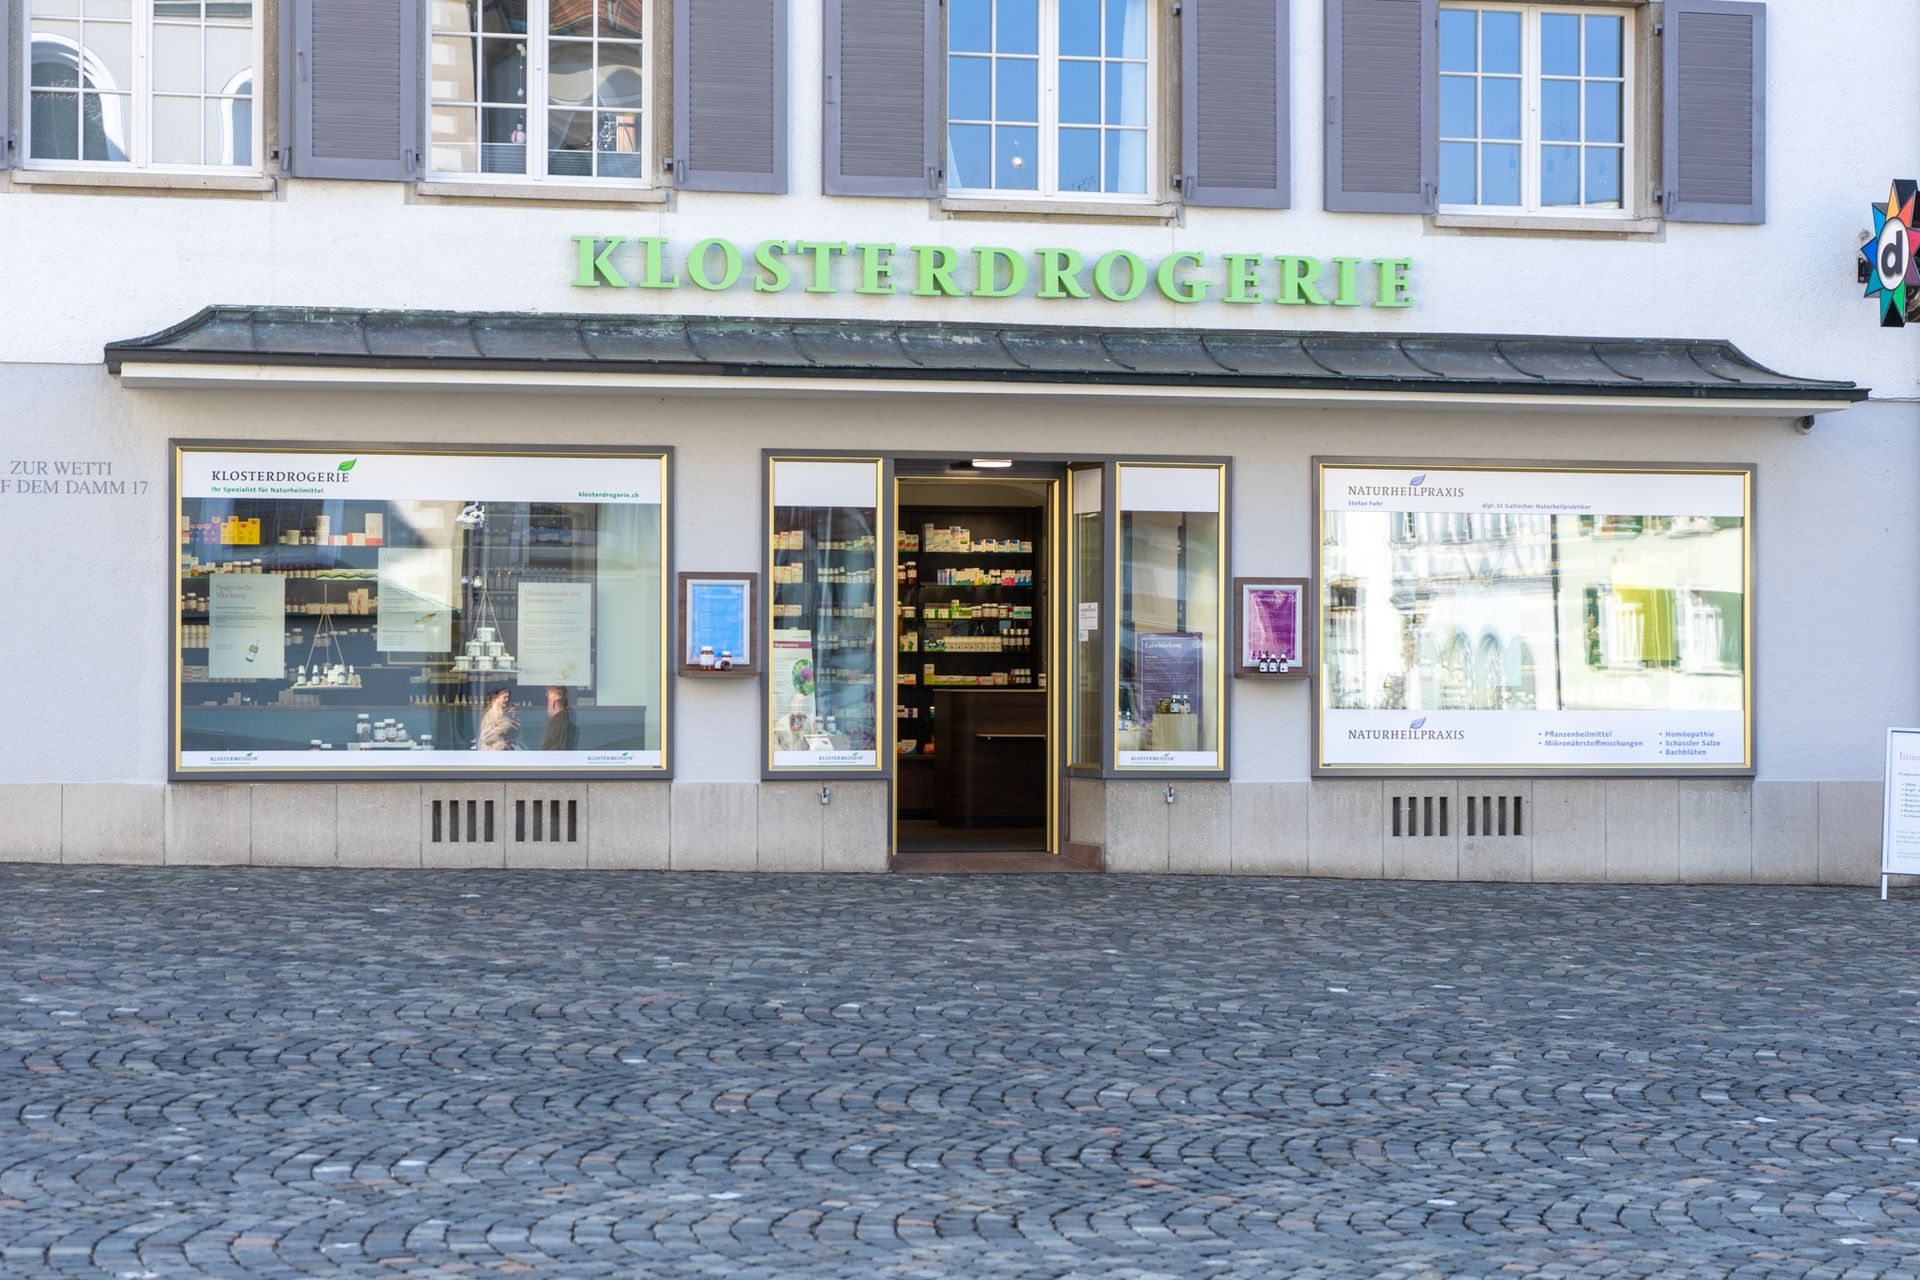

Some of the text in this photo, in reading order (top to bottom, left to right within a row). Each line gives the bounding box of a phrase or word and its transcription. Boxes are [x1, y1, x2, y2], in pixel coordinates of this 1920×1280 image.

[1881, 230, 1902, 278] d
[571, 236, 1412, 308] KLOSTERDROGERIE
[10, 460, 112, 476] ZUR WETTI
[212, 470, 349, 483] KLOSTERDROGERIE
[0, 479, 148, 495] F DEM DAMM 17
[1348, 486, 1464, 497] NATURHEILPRAXIS
[578, 491, 640, 499] klosterdrogerie.ch
[1348, 730, 1464, 740] NATURHEILPRAXIS
[1665, 731, 1715, 739] Homöopathie
[1545, 740, 1644, 748] Mikronährstoffmischungen
